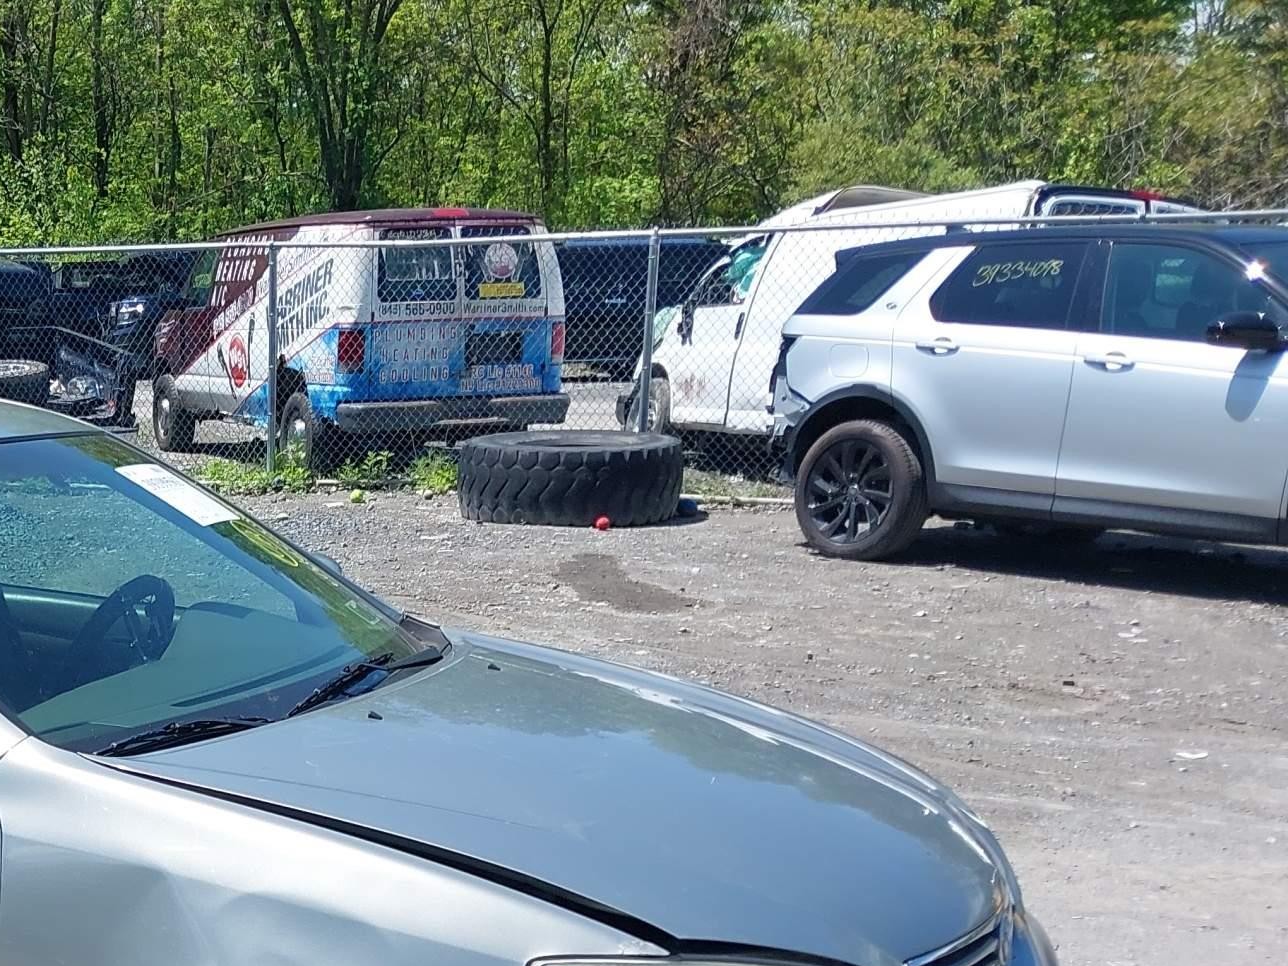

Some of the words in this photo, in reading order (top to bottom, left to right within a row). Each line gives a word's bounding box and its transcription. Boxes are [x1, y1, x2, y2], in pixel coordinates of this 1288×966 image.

[215, 259, 257, 282] HEATING
[972, 259, 1064, 288] 39334098
[210, 285, 229, 307] A/C
[266, 258, 334, 331] ARRINER
[305, 289, 330, 330] INC.
[374, 327, 457, 343] PLUMBING
[381, 347, 450, 363] HEATING
[379, 368, 450, 384] COOLING
